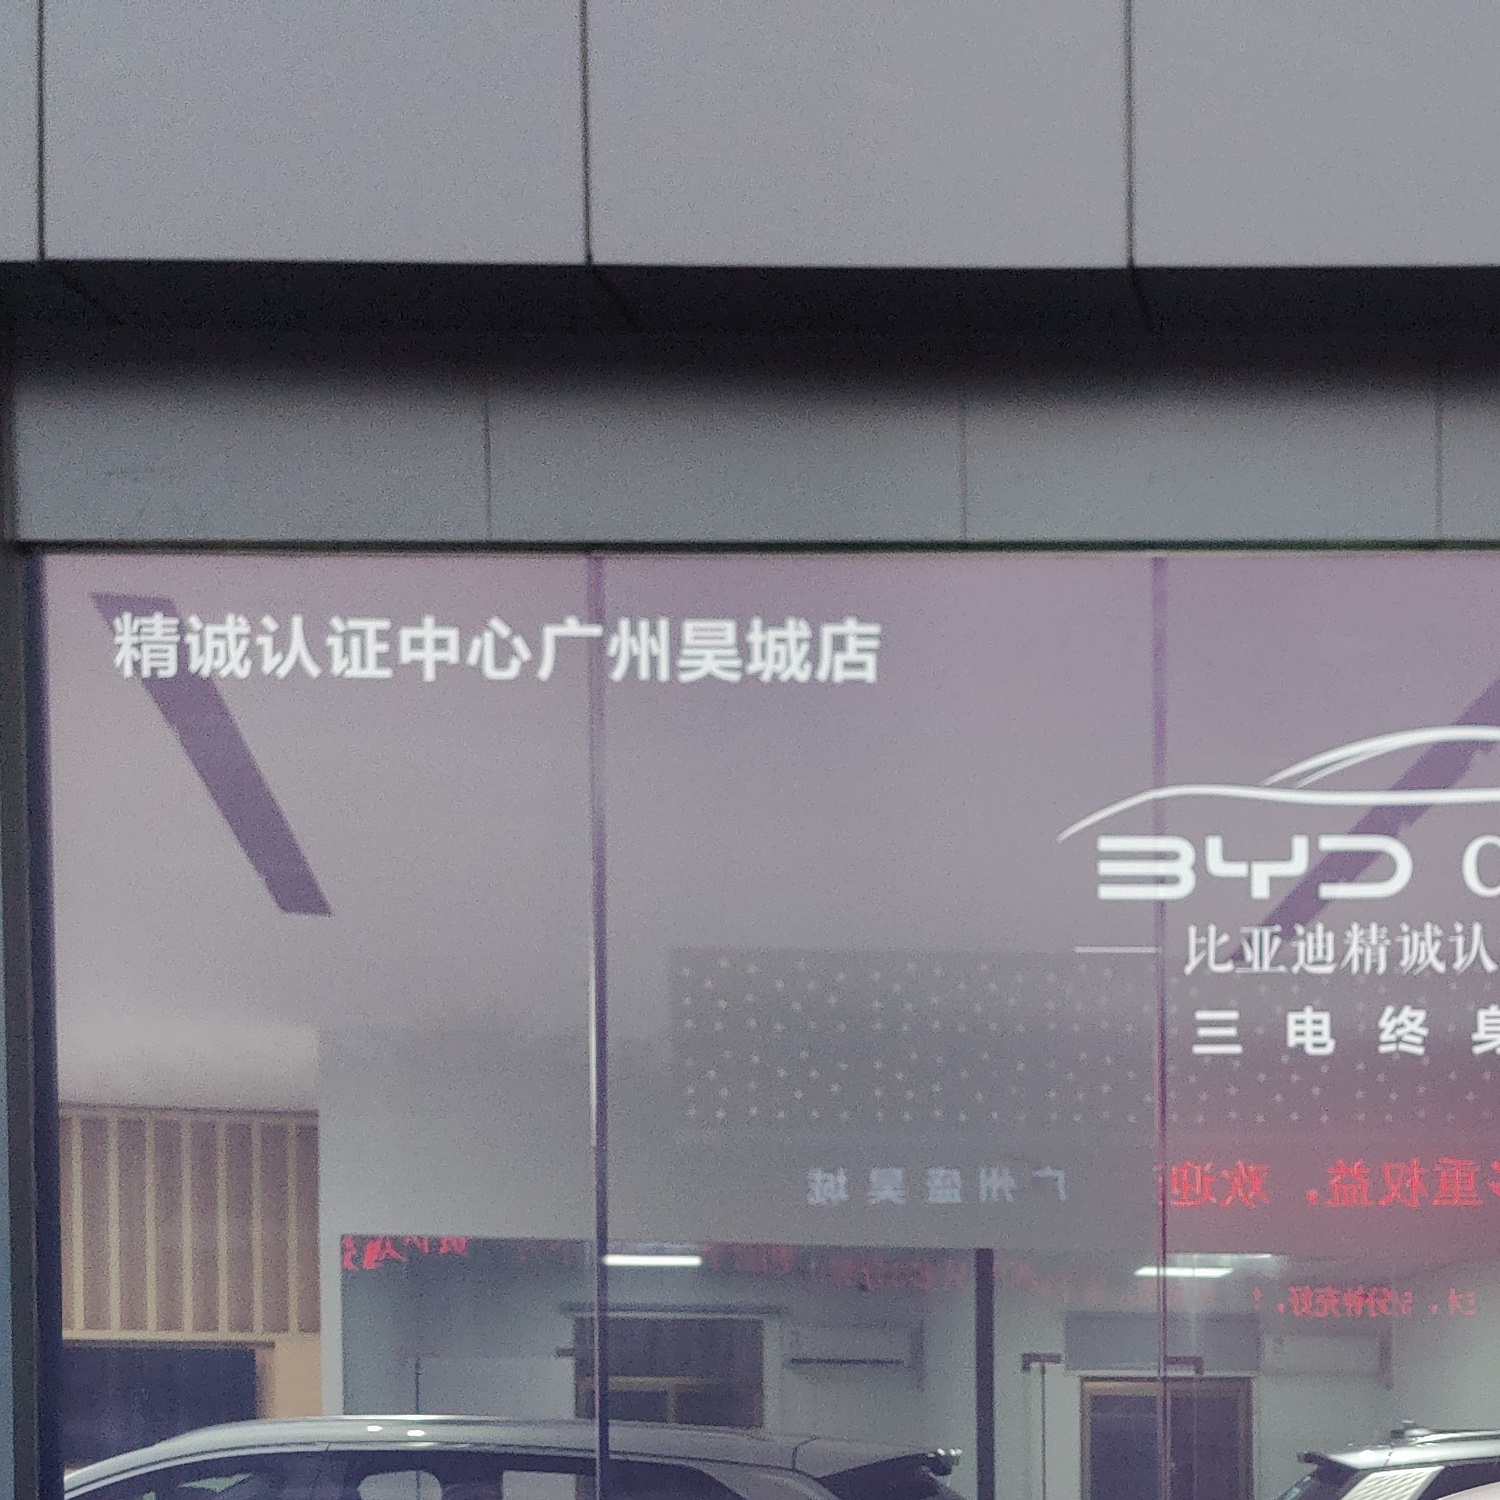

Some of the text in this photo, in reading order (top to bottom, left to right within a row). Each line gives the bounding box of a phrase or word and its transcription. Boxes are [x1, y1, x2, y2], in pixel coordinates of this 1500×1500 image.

[112, 612, 882, 683] 精诚认证中心广州昊城店
[1096, 834, 1413, 899] BYD
